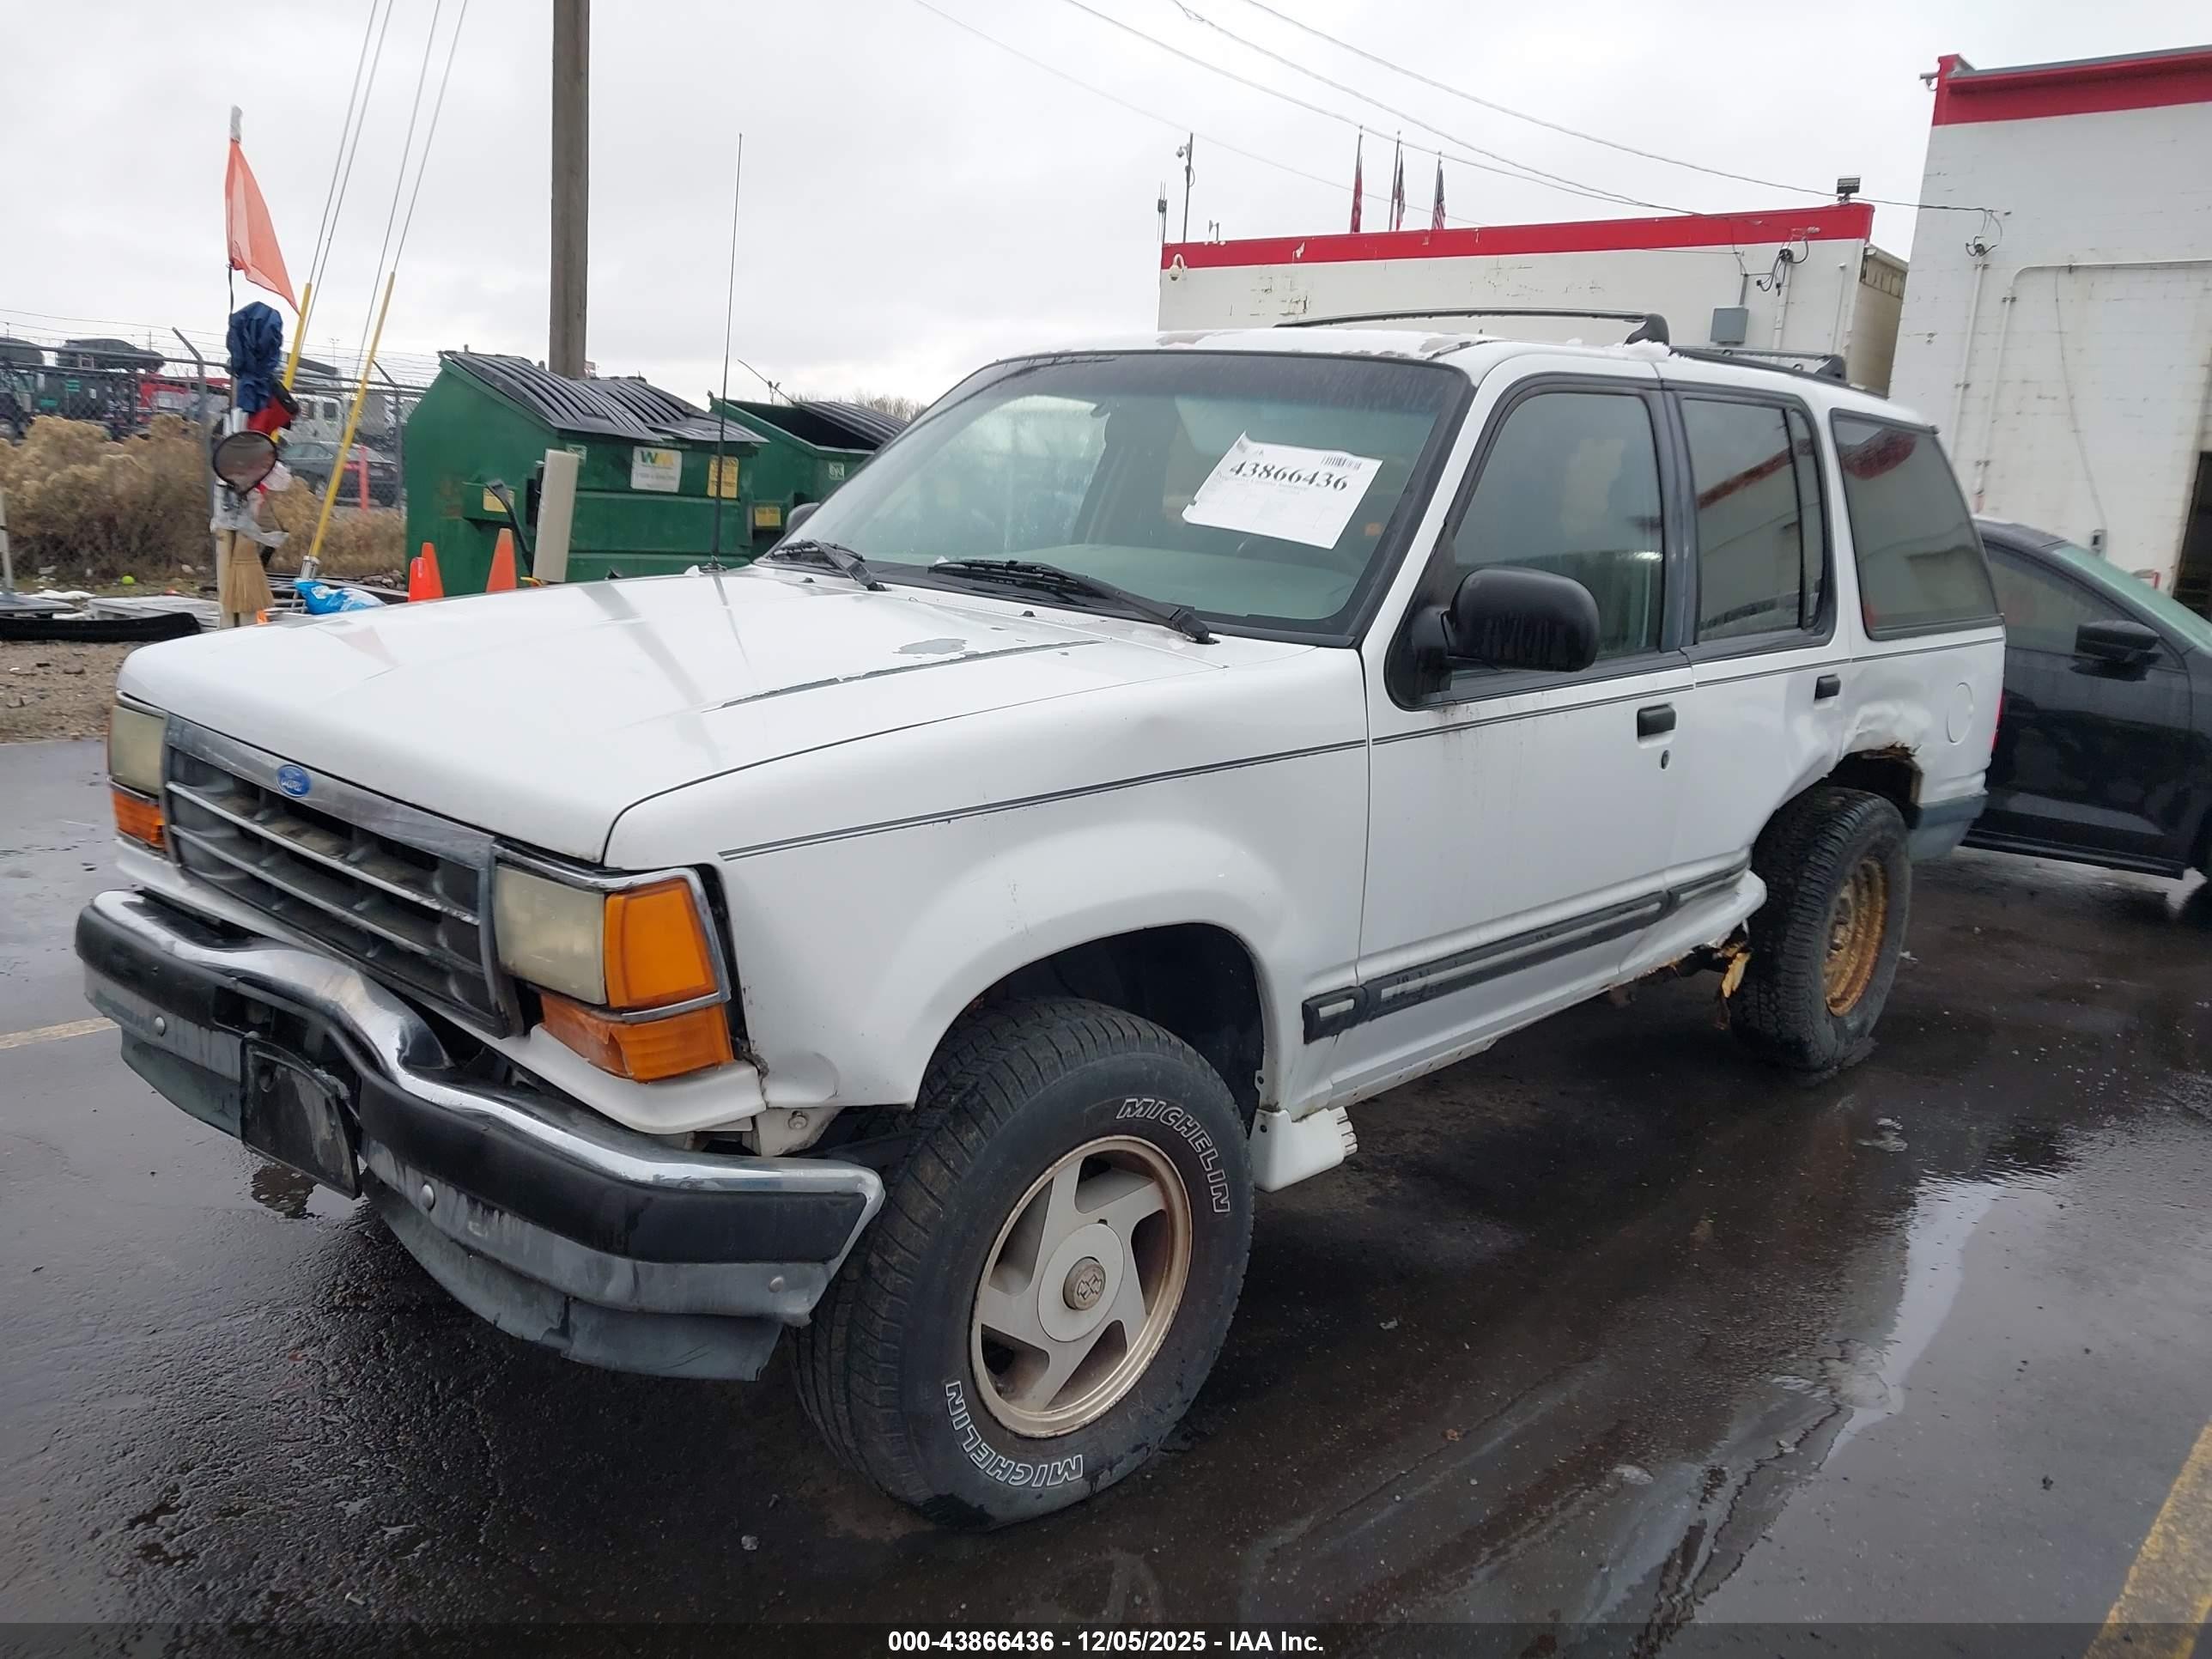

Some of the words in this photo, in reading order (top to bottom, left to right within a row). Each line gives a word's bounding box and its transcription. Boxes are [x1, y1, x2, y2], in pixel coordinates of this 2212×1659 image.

[1230, 460, 1348, 491] 43866436
[1116, 1098, 1232, 1213] MICHELIN
[945, 1380, 1084, 1488] MICHELIN
